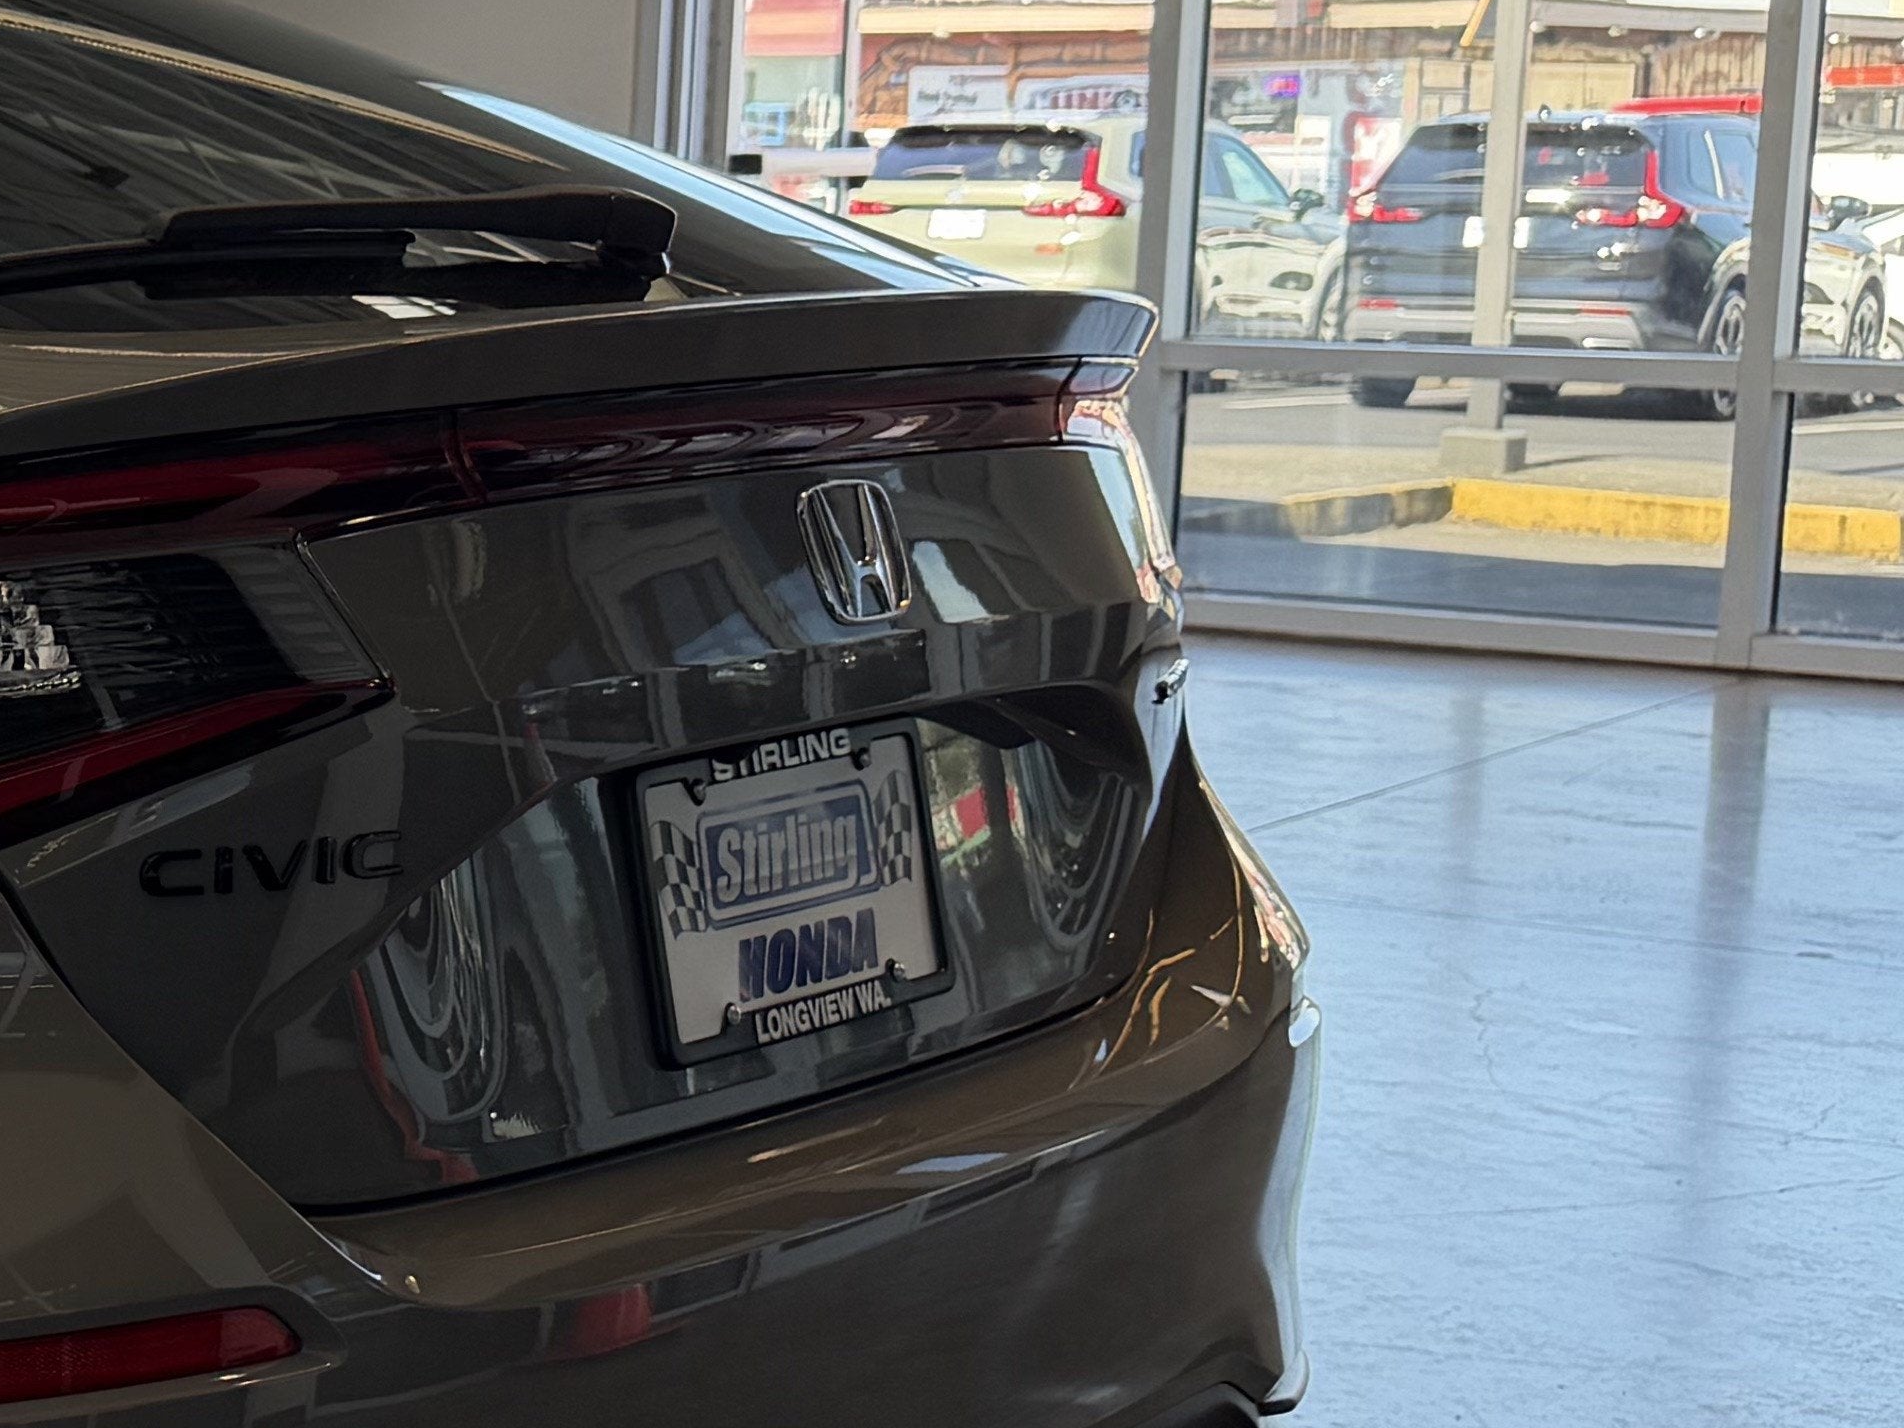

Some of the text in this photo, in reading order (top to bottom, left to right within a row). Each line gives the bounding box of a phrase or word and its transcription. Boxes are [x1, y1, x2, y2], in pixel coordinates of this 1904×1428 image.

[139, 830, 404, 898] CIVIC
[715, 812, 857, 904] Stirling
[738, 908, 879, 1003] HONDA
[755, 989, 856, 1044] LONGVIEW
